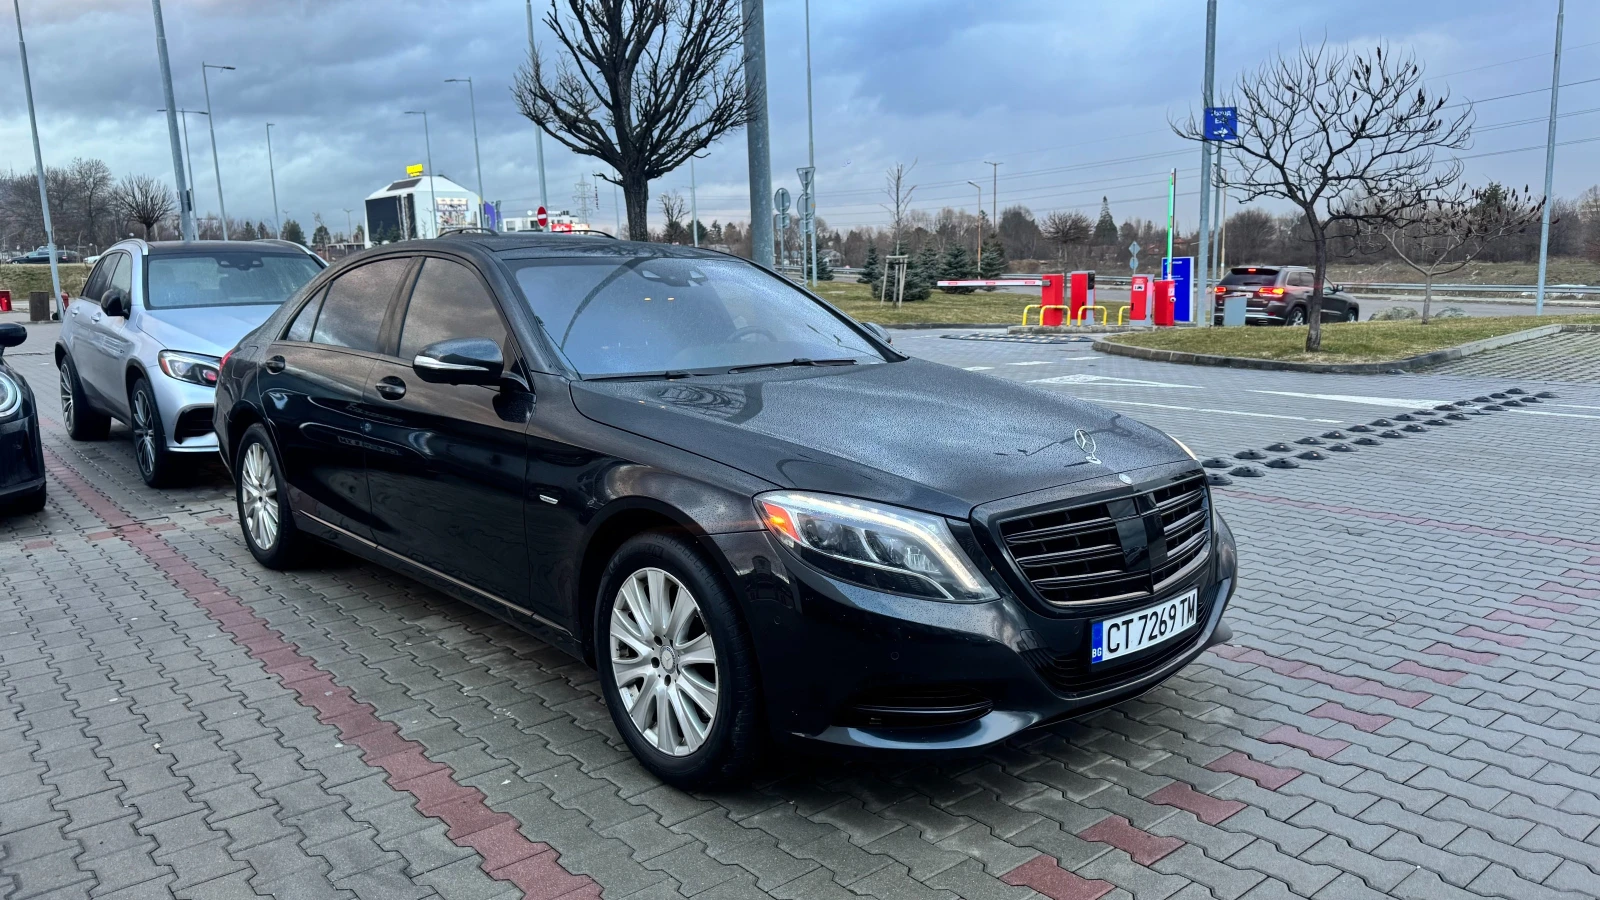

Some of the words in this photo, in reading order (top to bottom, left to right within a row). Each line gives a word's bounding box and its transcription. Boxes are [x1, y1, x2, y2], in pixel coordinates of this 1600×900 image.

[1107, 618, 1133, 653] CT
[1138, 604, 1176, 645] 7269
[1180, 593, 1195, 627] TM
[1092, 647, 1102, 658] BG
